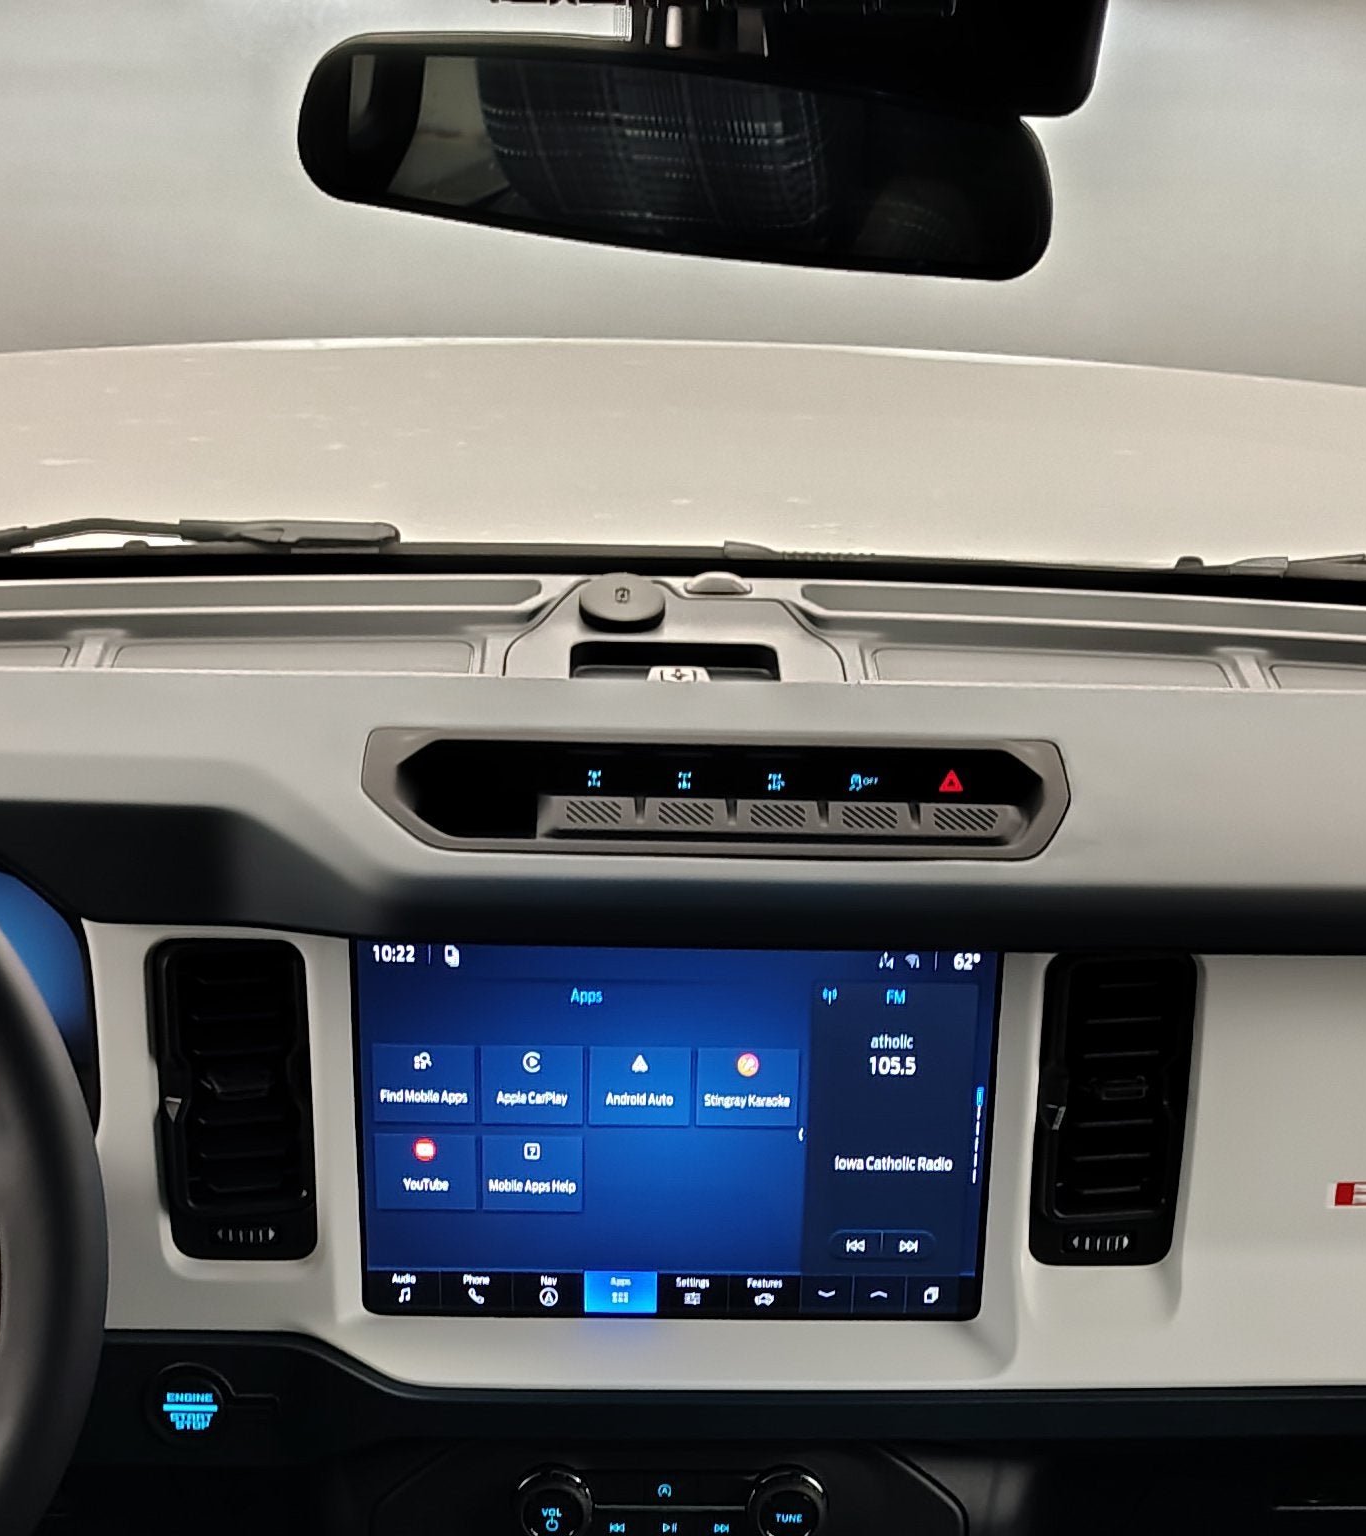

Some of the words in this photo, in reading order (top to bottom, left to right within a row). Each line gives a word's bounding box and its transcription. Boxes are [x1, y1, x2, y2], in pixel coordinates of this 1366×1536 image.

[372, 944, 416, 963] 10:22
[953, 953, 981, 970] 62°
[570, 987, 603, 1005] Apps
[886, 989, 906, 1005] FM
[870, 1034, 914, 1050] atholic
[869, 1056, 917, 1075] 105.5
[379, 1088, 404, 1103] Find
[404, 1088, 439, 1103] Mobile
[440, 1090, 468, 1106] Apps
[496, 1090, 527, 1106] Apple
[527, 1090, 568, 1107] CarPlay
[605, 1091, 646, 1106] Android
[648, 1092, 674, 1107] Auto
[704, 1093, 746, 1109] Stingray
[747, 1094, 791, 1108] Karaoke
[865, 1155, 916, 1172] Catholic
[917, 1157, 953, 1172] Radio
[402, 1177, 450, 1192] YouTube
[488, 1178, 523, 1193] Mobile
[524, 1180, 551, 1195] Apps
[551, 1179, 577, 1195] Help
[391, 1273, 417, 1285] Audio
[463, 1273, 490, 1286] Phone
[540, 1275, 557, 1287] Nav
[610, 1276, 632, 1288] Apps
[676, 1276, 710, 1289] Settings
[746, 1277, 783, 1289] Features
[166, 1391, 214, 1403] ENGINE
[541, 1507, 562, 1518] VOL
[775, 1513, 803, 1523] TUNE
